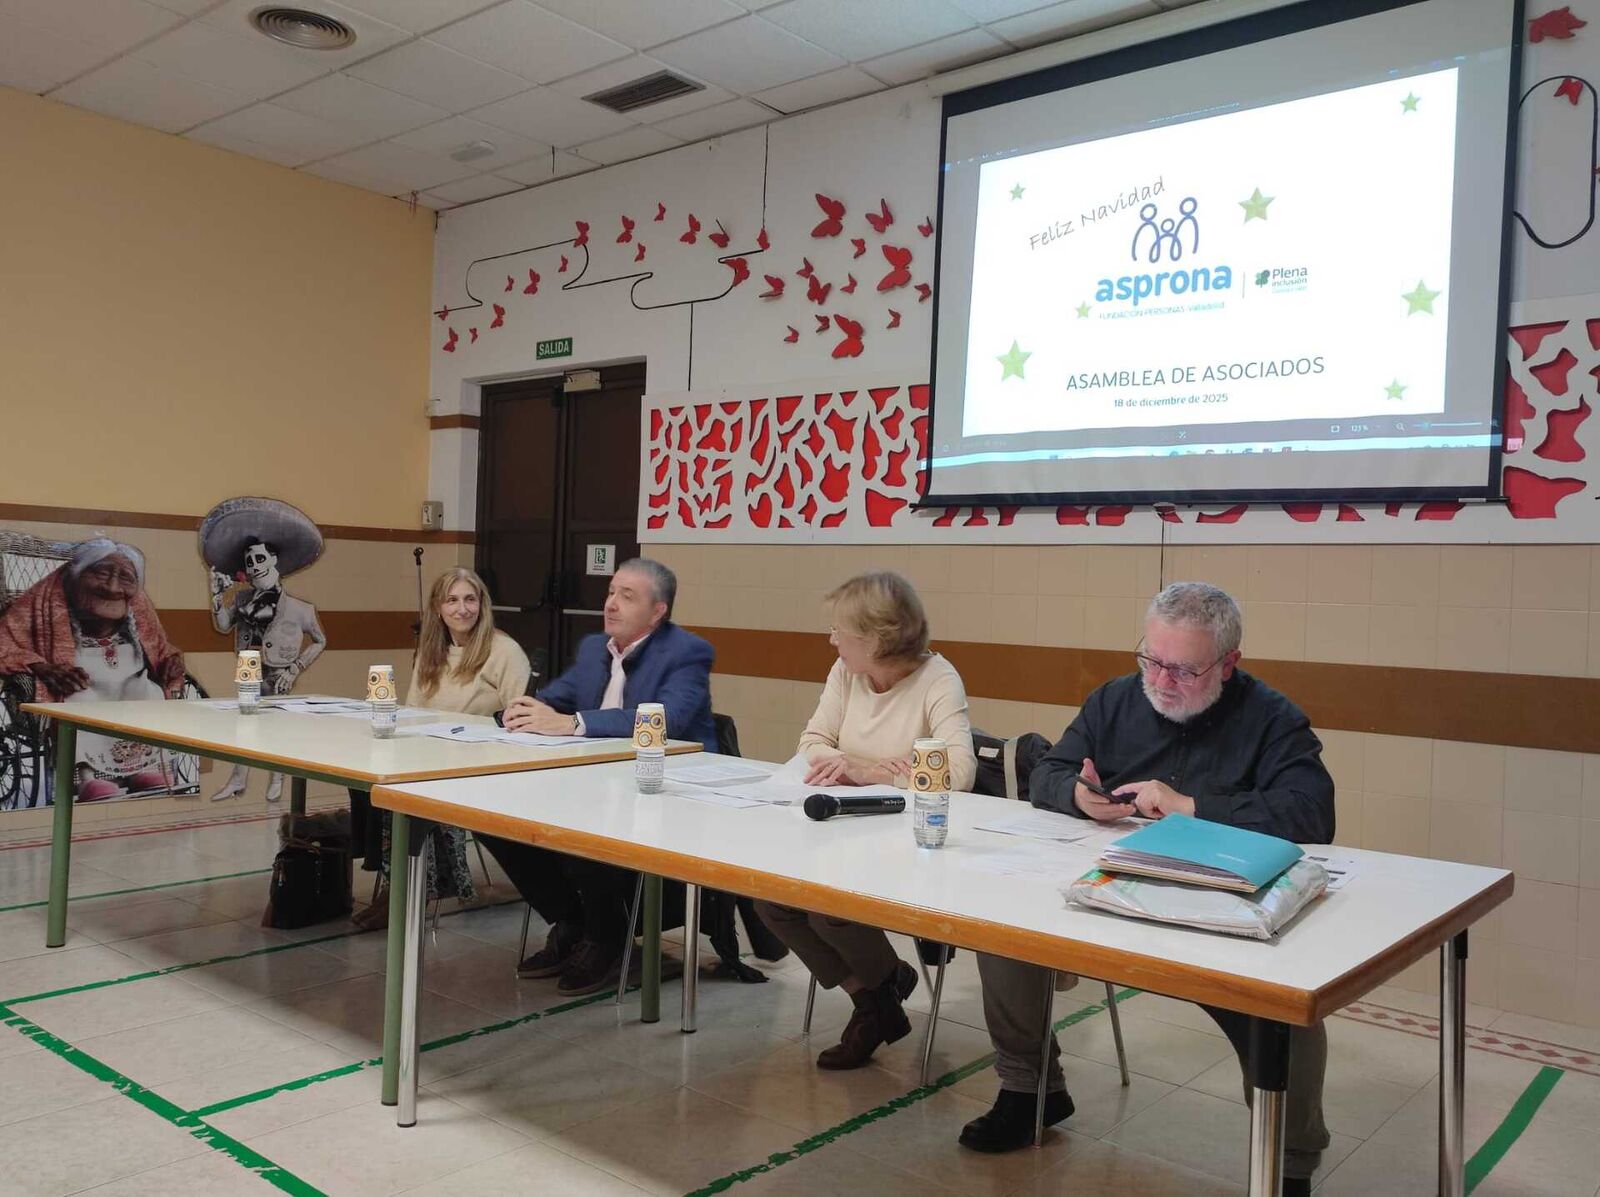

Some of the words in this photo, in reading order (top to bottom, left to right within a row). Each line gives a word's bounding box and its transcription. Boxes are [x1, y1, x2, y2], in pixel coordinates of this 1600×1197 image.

[1029, 221, 1075, 250] Feliz
[1081, 175, 1165, 227] Navidad
[1095, 265, 1232, 307] asprona
[1272, 266, 1308, 280] Plena
[539, 340, 569, 356] SALIDA
[1066, 369, 1166, 391] ASAMBLEA
[1171, 366, 1196, 384] DE
[1202, 356, 1325, 382] ASOCIADOS
[1114, 398, 1124, 408] 18
[1125, 397, 1138, 408] de
[1139, 395, 1186, 407] diciembre
[1187, 394, 1200, 405] de
[1202, 391, 1229, 404] 2025
